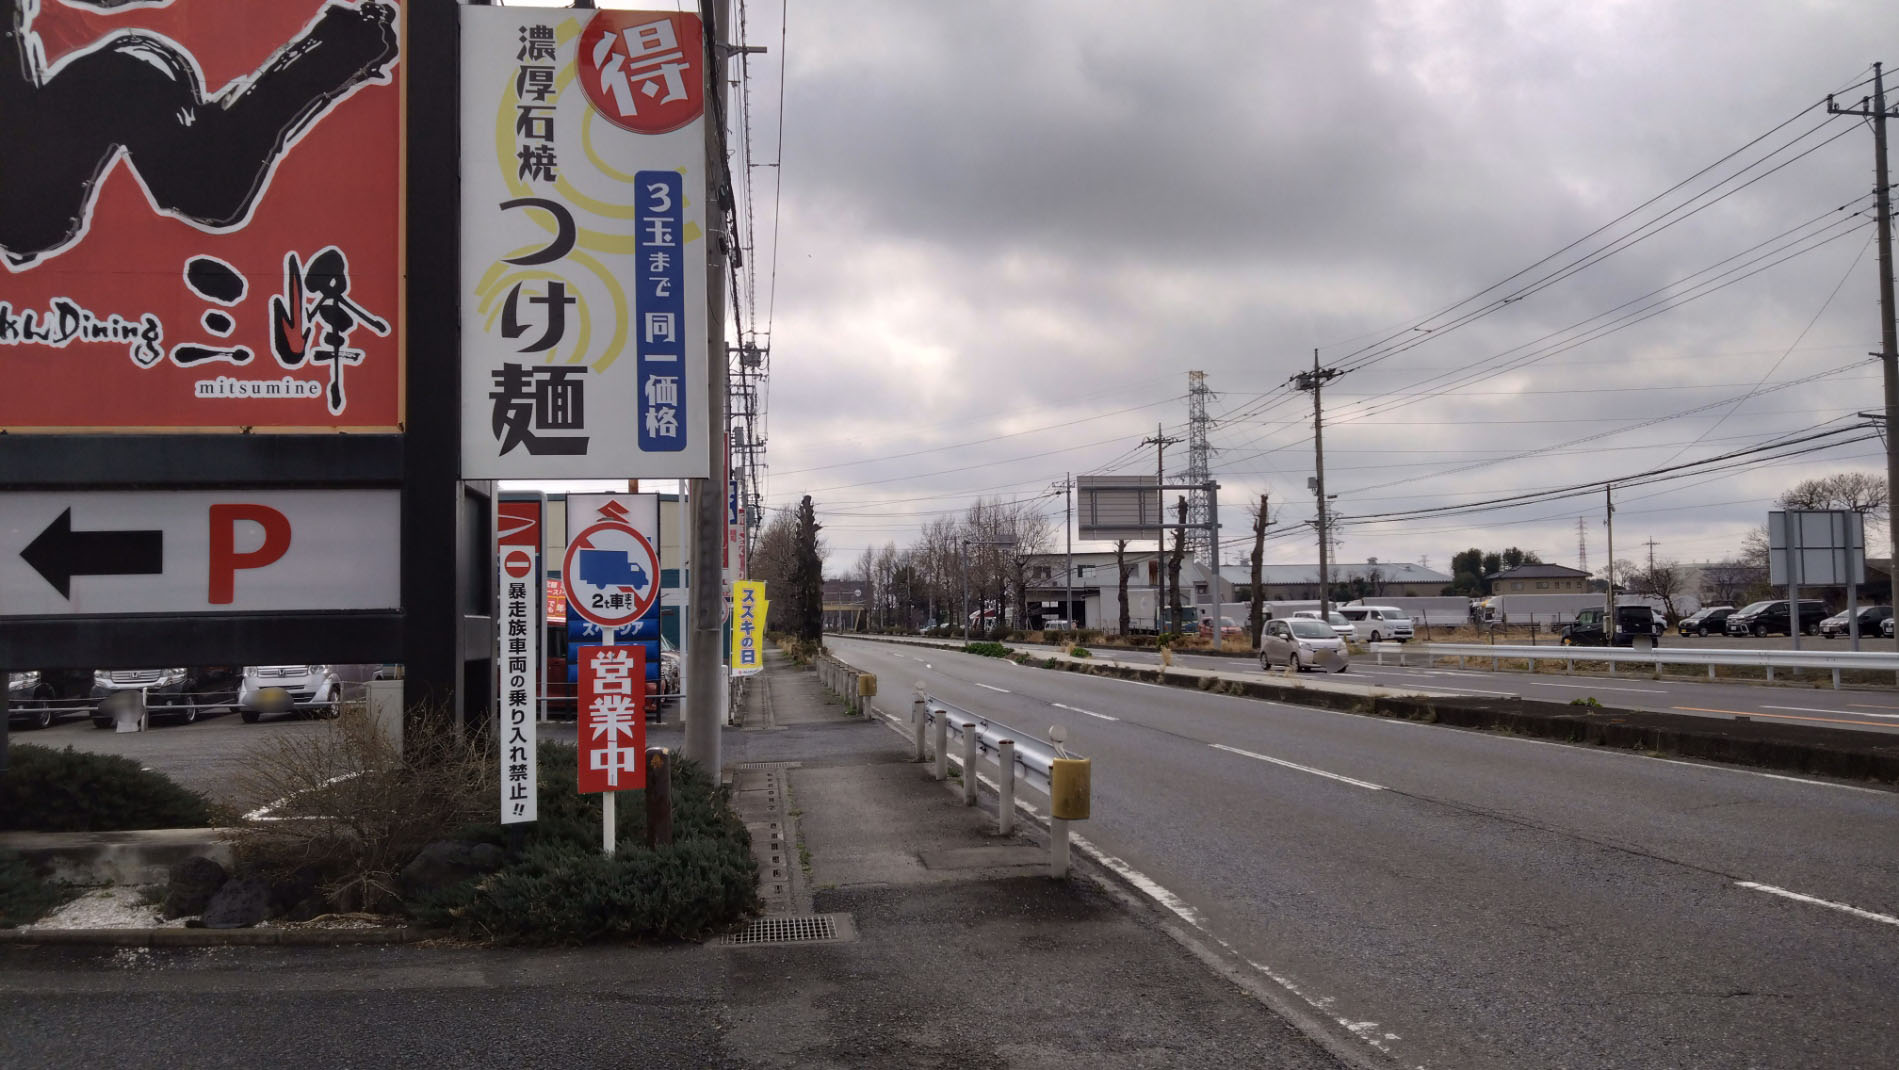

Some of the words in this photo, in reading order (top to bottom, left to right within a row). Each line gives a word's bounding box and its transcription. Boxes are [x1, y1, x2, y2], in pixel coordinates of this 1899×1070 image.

[516, 25, 557, 182] 濃厚石焼
[592, 18, 690, 117] 得
[488, 197, 590, 457] つけ麺
[642, 182, 679, 438] 3玉まで同一価格
[199, 379, 319, 396] mitsumine
[209, 504, 291, 605] P
[589, 649, 635, 786] 営業中
